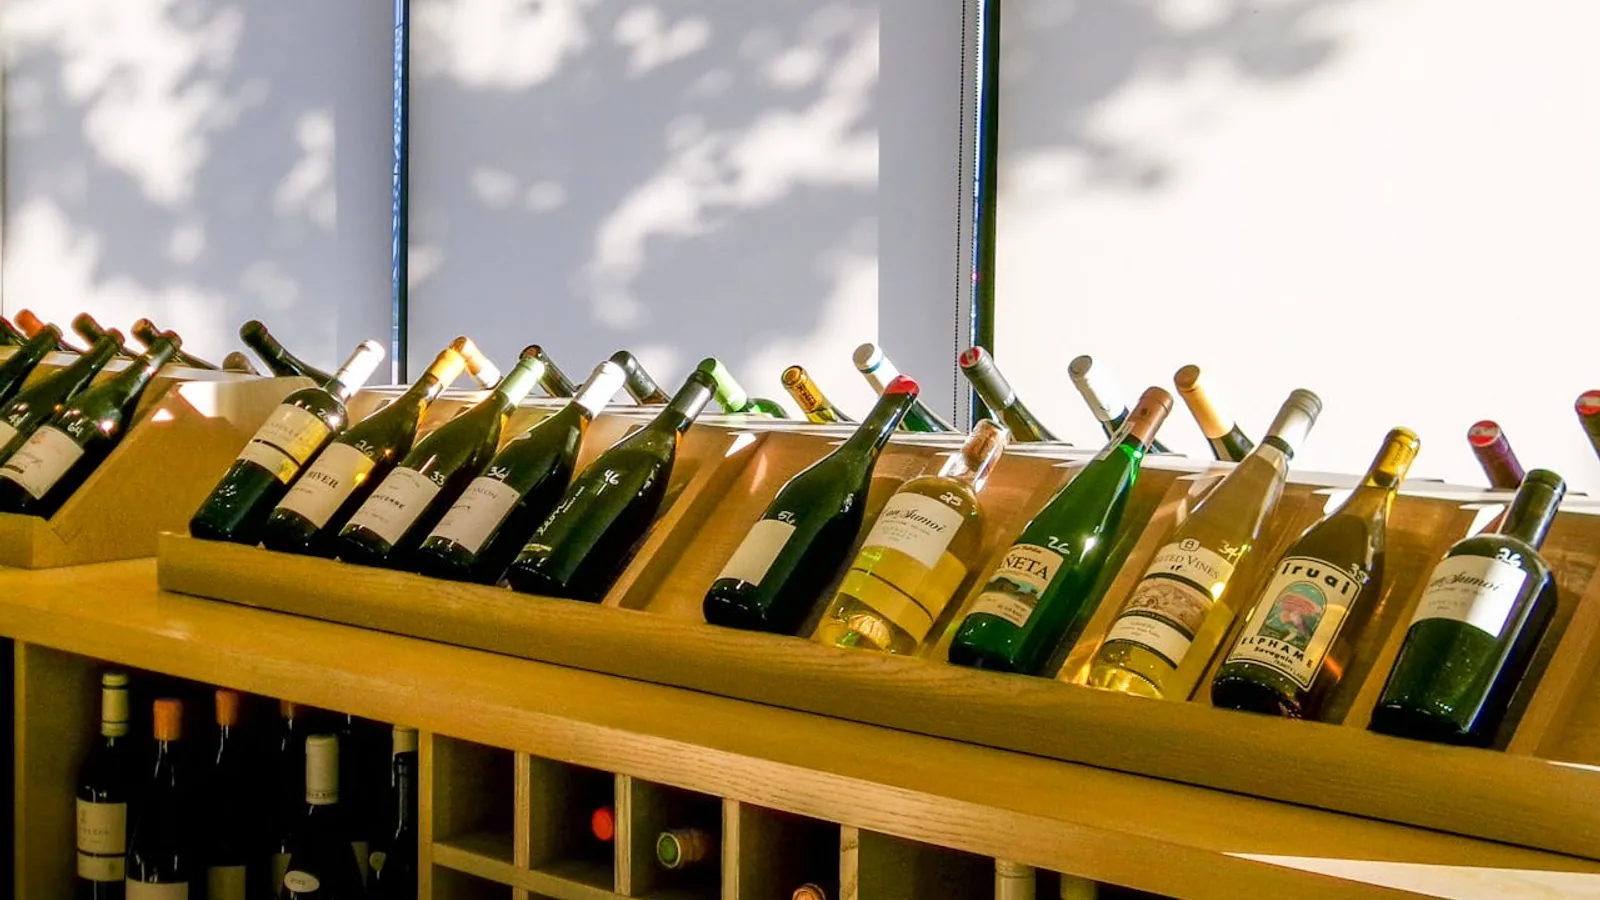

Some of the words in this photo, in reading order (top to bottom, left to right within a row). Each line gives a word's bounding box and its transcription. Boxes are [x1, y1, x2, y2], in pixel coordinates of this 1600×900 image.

[430, 470, 446, 486] 33
[604, 469, 620, 485] 46
[1047, 535, 1070, 555] 26
[1183, 540, 1195, 550] B
[1002, 553, 1049, 581] ÑETA
